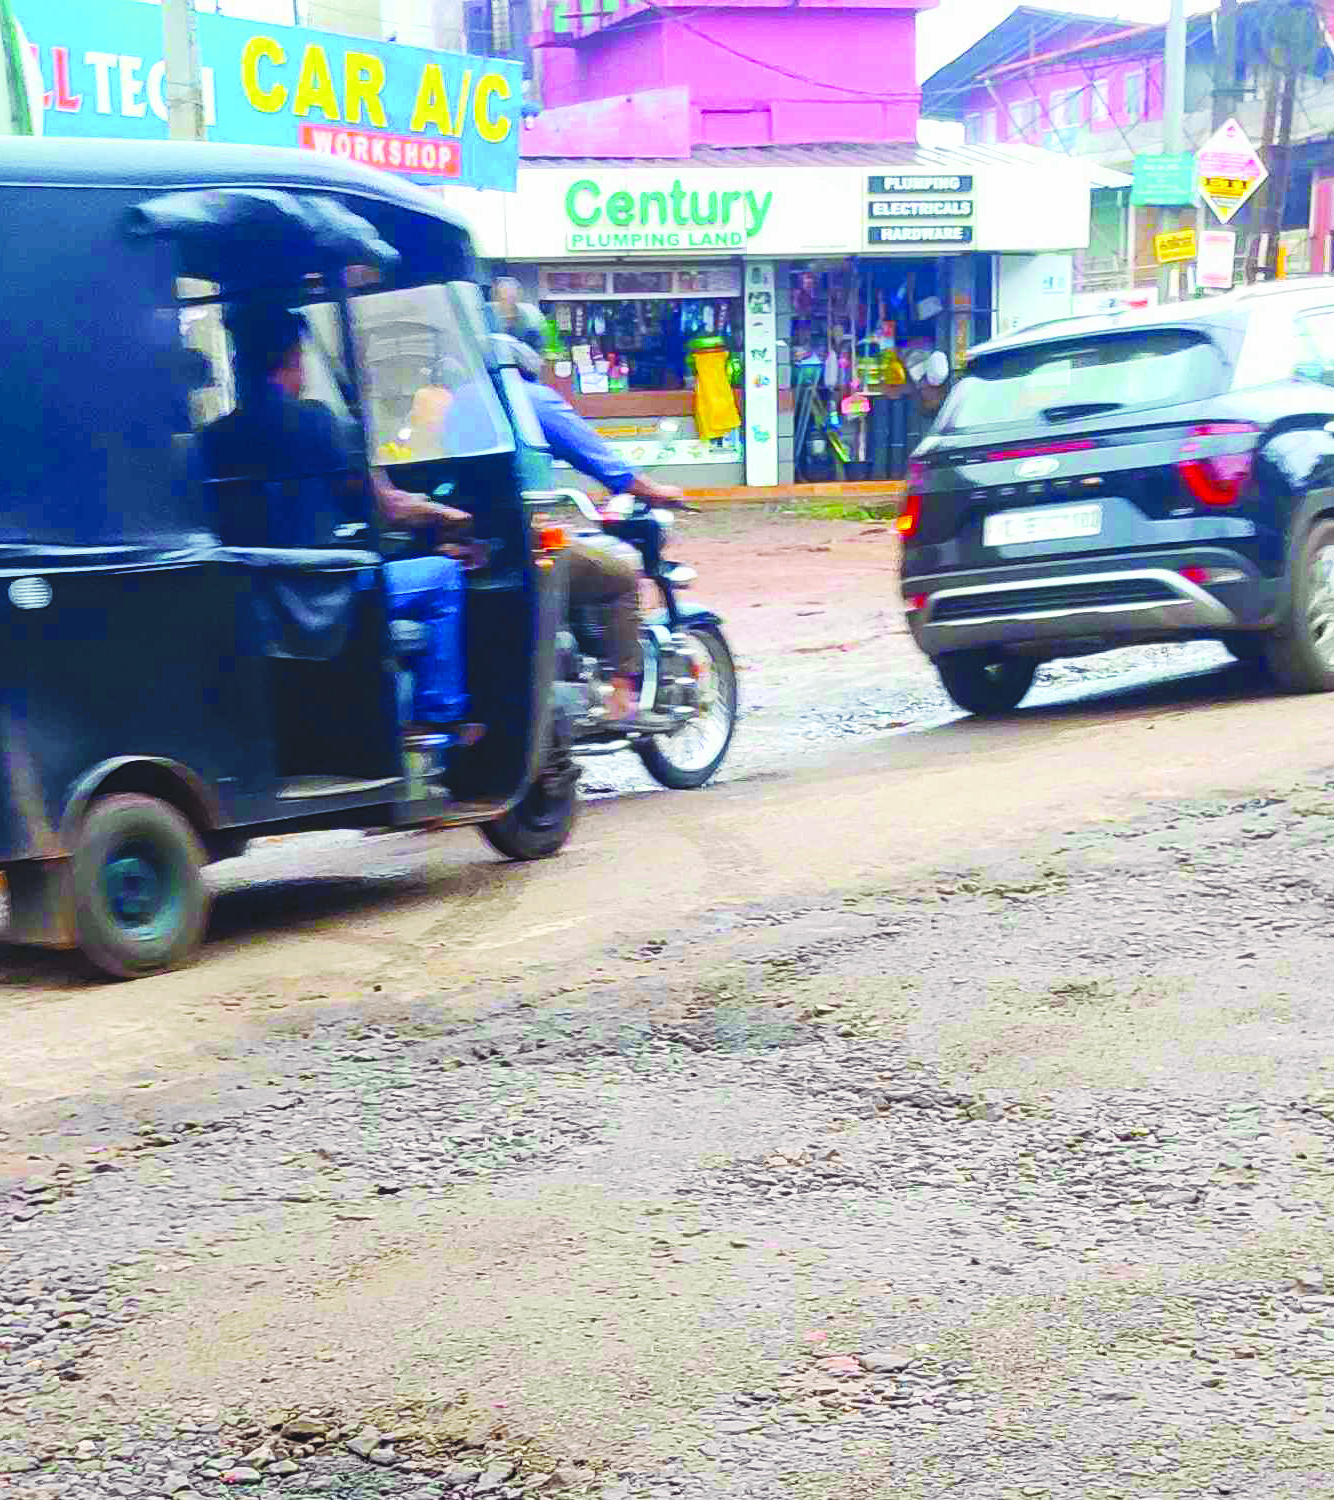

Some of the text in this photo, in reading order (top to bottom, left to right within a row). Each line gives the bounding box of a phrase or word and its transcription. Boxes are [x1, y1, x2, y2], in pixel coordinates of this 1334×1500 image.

[240, 34, 513, 144] CAR A/C
[312, 129, 453, 171] WORKSHOP
[565, 179, 774, 238] Century
[871, 200, 972, 218] ELECTRICALS
[571, 230, 744, 249] PLUMPING LAND
[880, 226, 965, 242] HARDWARE
